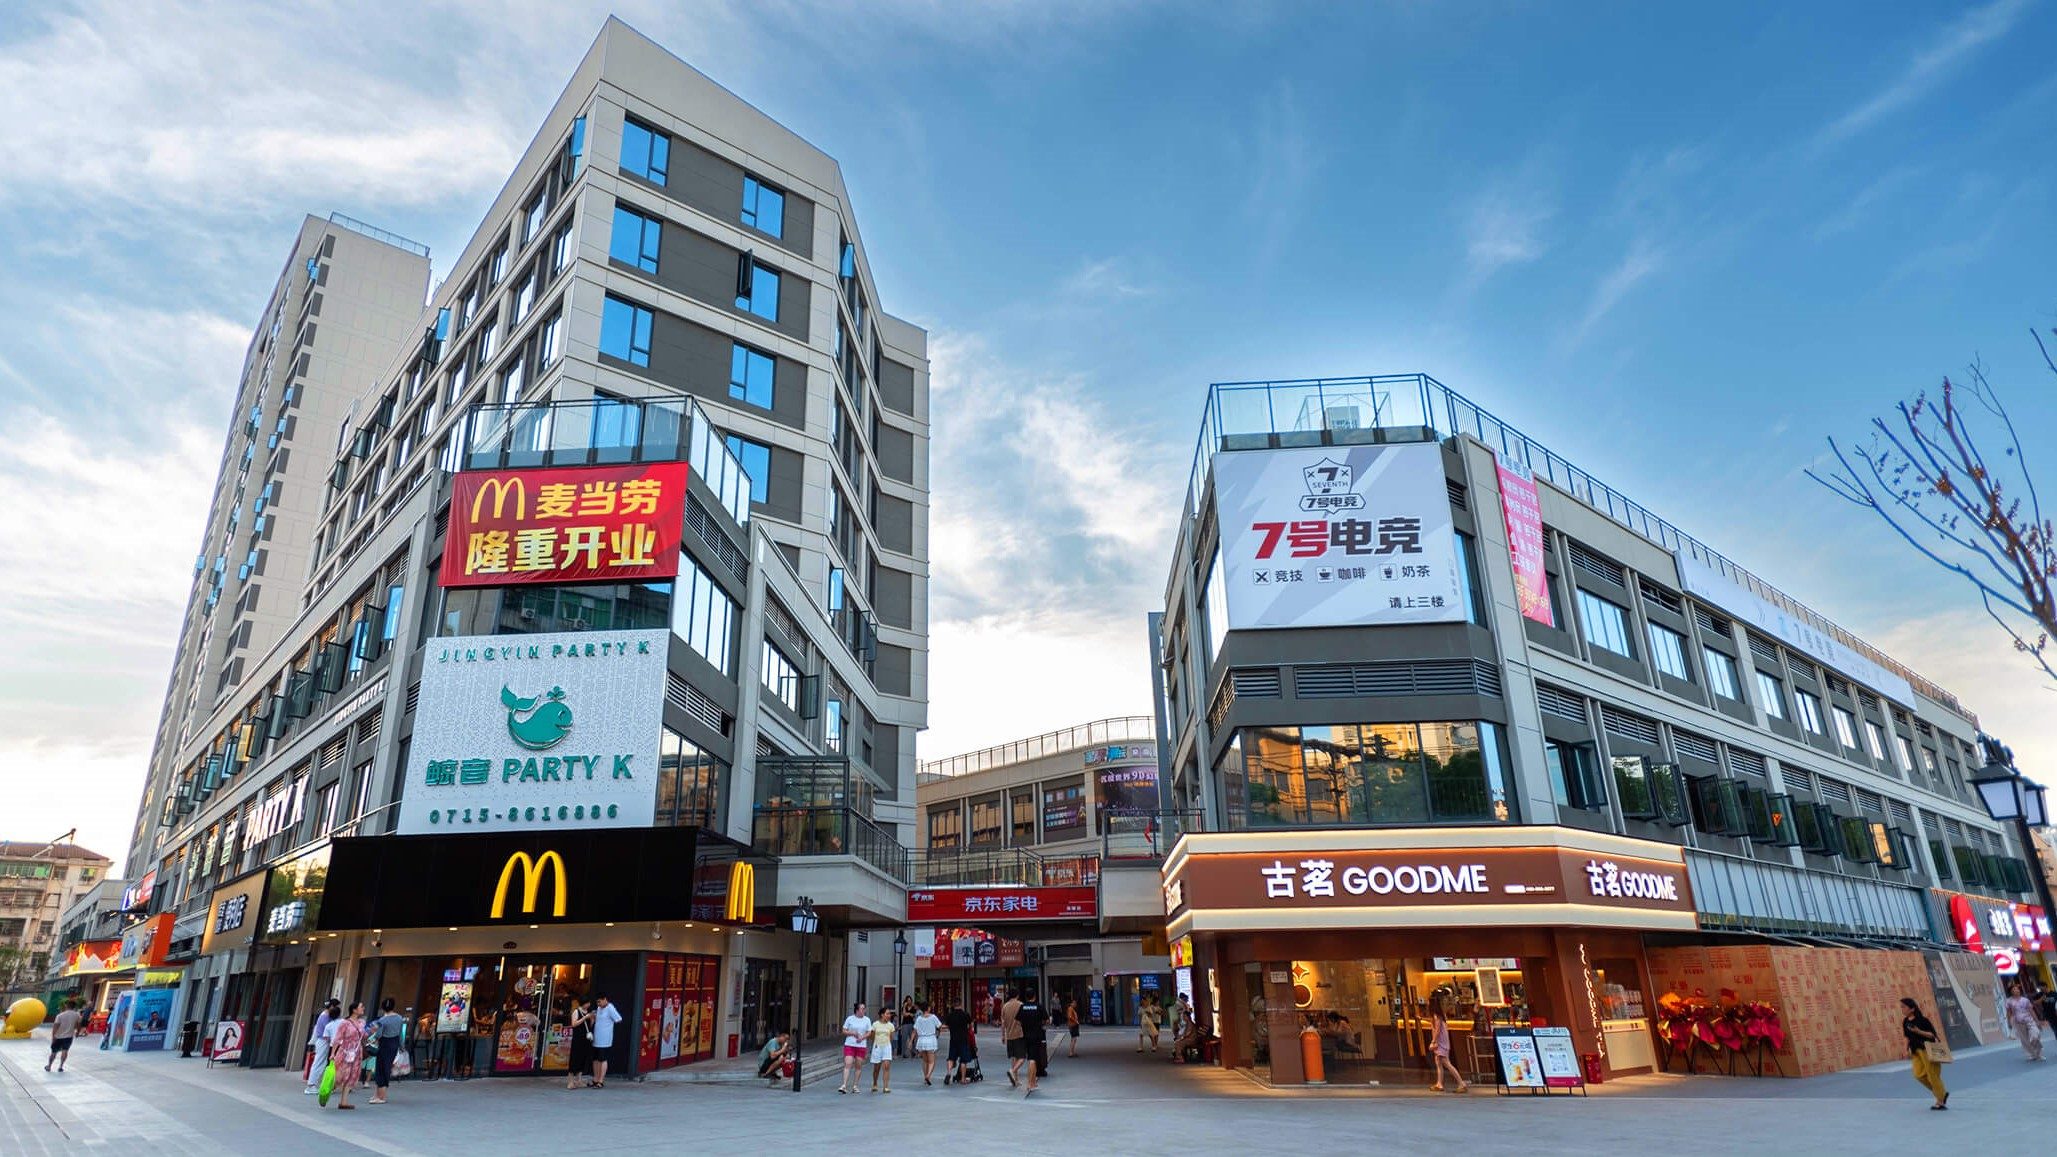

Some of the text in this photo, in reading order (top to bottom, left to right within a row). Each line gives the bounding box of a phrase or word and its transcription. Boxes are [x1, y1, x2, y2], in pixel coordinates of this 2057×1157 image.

[1312, 481, 1349, 489] SEVENTH
[535, 479, 661, 520] 麦当劳
[1306, 496, 1358, 509] 7号电竞
[1252, 518, 1422, 559] 7号电竞
[465, 523, 656, 576] 隆重开业
[1275, 569, 1303, 583] 竞技
[1337, 567, 1366, 581] 咖啡
[1401, 565, 1430, 577] 奶茶
[1389, 595, 1445, 608] 请上三楼
[439, 640, 650, 663] JINGYIN PARTY K
[425, 754, 633, 786] 鲸音 PARTY K
[242, 784, 294, 852] PARTY
[429, 804, 619, 824] 0715-8616886
[1261, 860, 1489, 898] 古茗 GOODME
[1586, 860, 1678, 900] 古茗 GOODME
[965, 896, 1038, 913] 京东家电
